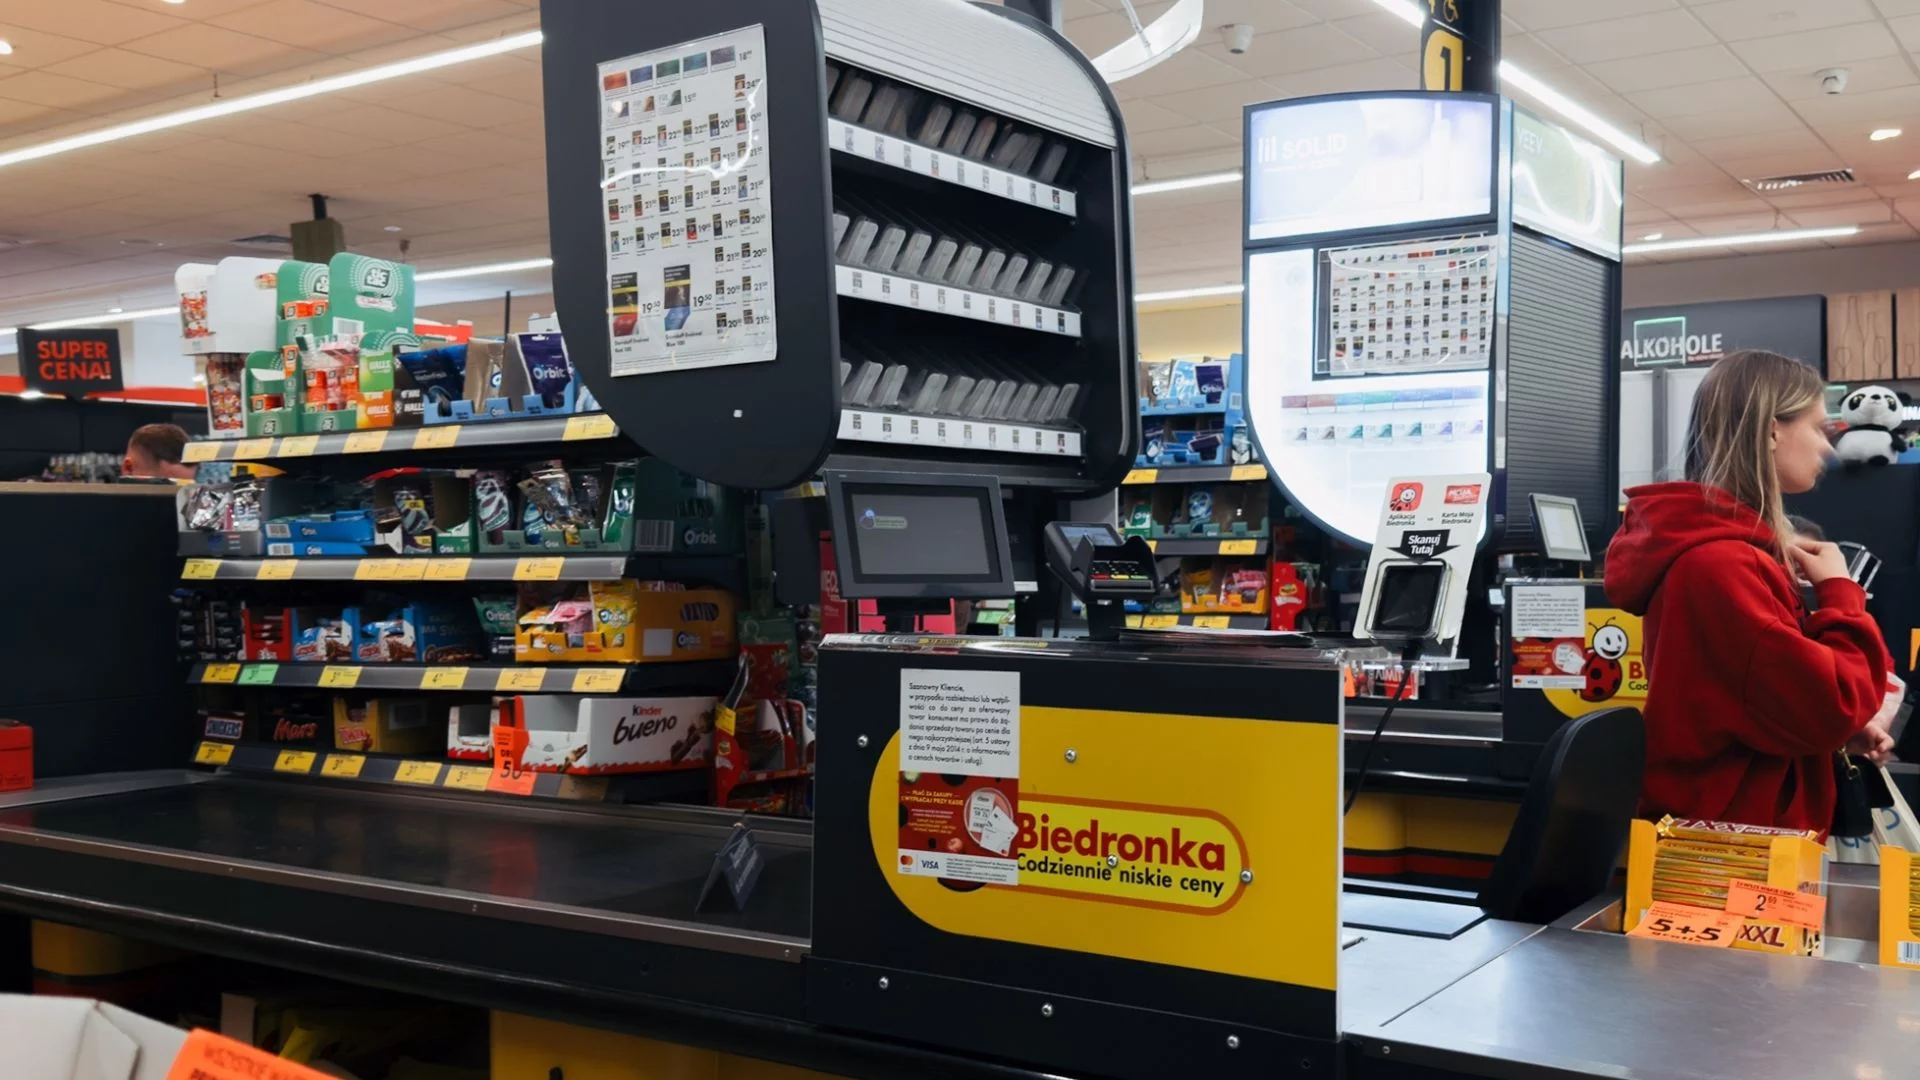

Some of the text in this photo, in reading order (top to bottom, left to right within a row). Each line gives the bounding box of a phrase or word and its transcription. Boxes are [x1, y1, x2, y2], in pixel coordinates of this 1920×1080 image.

[37, 340, 109, 359] SUPER
[1621, 333, 1723, 359] ALKOHOLE
[38, 361, 112, 380] CENA!
[533, 364, 566, 380] Orbit
[685, 528, 716, 546] Orbit
[1408, 534, 1441, 546] Skanuj
[1411, 545, 1434, 556] Tutaj
[274, 718, 317, 741] Mars
[613, 716, 677, 746] bueno
[1017, 812, 1225, 872] Biedronka
[921, 860, 939, 869] VISA
[1017, 853, 1112, 881] Codziennie
[1120, 866, 1173, 888] niskie
[1180, 876, 1225, 898] ceny
[1740, 925, 1785, 948] XXL
